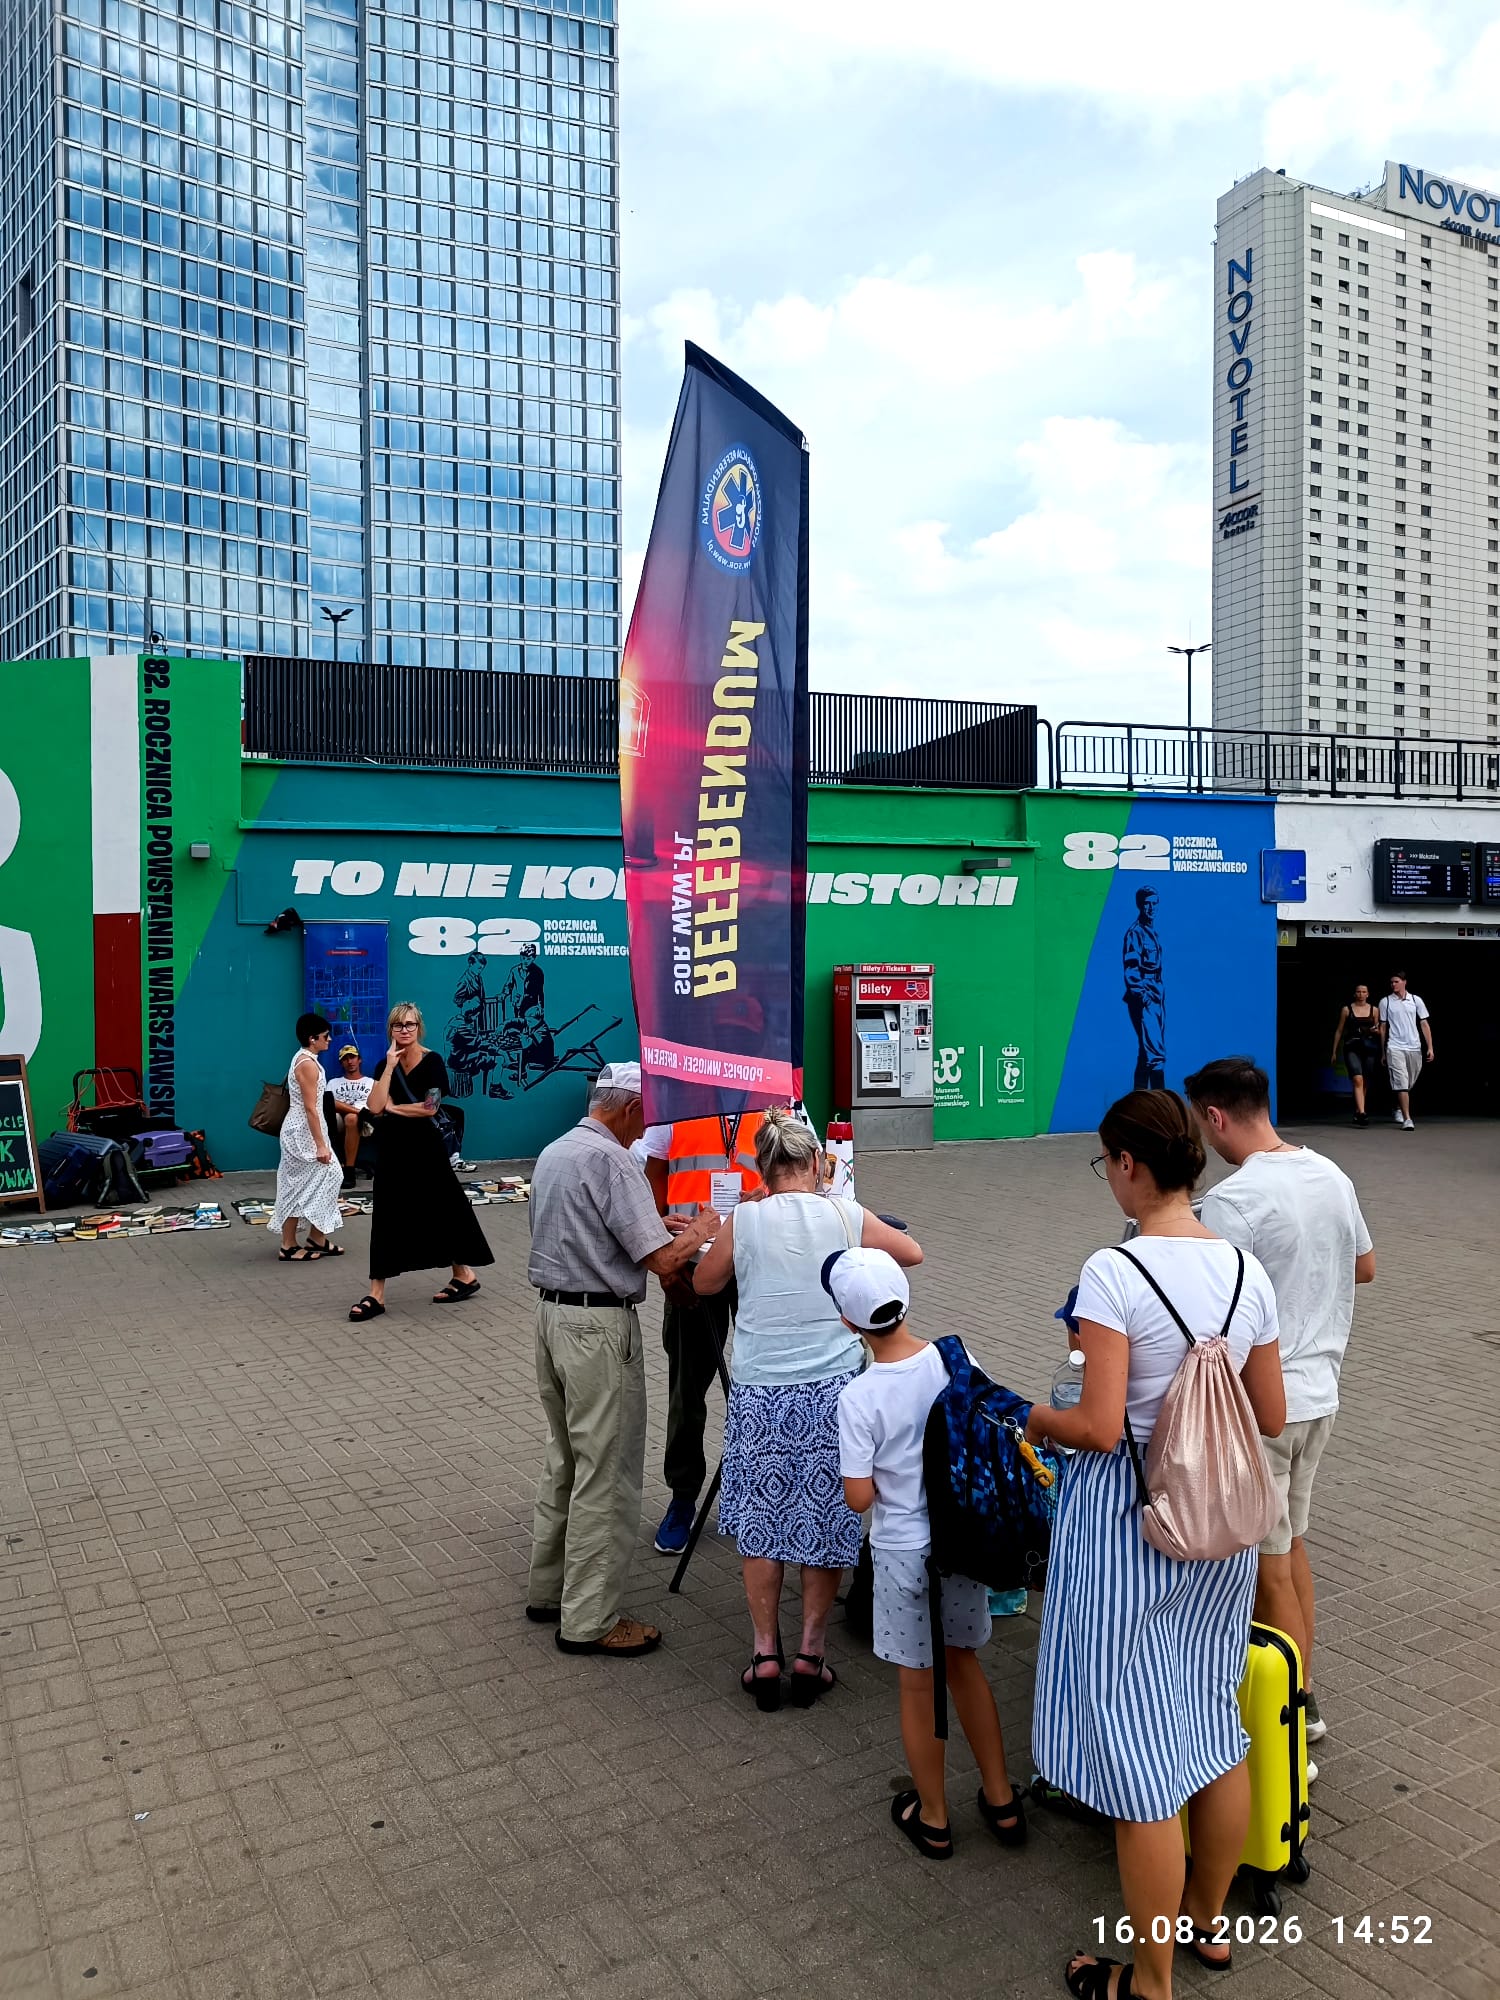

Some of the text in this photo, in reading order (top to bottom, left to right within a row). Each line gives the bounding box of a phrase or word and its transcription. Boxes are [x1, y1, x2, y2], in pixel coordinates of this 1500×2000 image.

[1227, 248, 1252, 494] NOVOTEL
[144, 658, 171, 694] 82.
[145, 699, 173, 819] ROCZNICA
[1063, 832, 1170, 871] 82
[1173, 836, 1217, 848] ROCZNICA
[1173, 849, 1223, 860] POWSTANIA
[292, 860, 626, 900] TO NIE KO
[1173, 861, 1247, 873] WARSZAWSKIEGO
[147, 825, 173, 961] POWSTANIA
[806, 872, 1018, 906] ISTORII
[408, 916, 541, 956] 82
[544, 919, 597, 931] ROCZNICA
[544, 932, 604, 944] POWSTANIA
[862, 965, 881, 973] Bilety
[860, 983, 892, 996] Bilety
